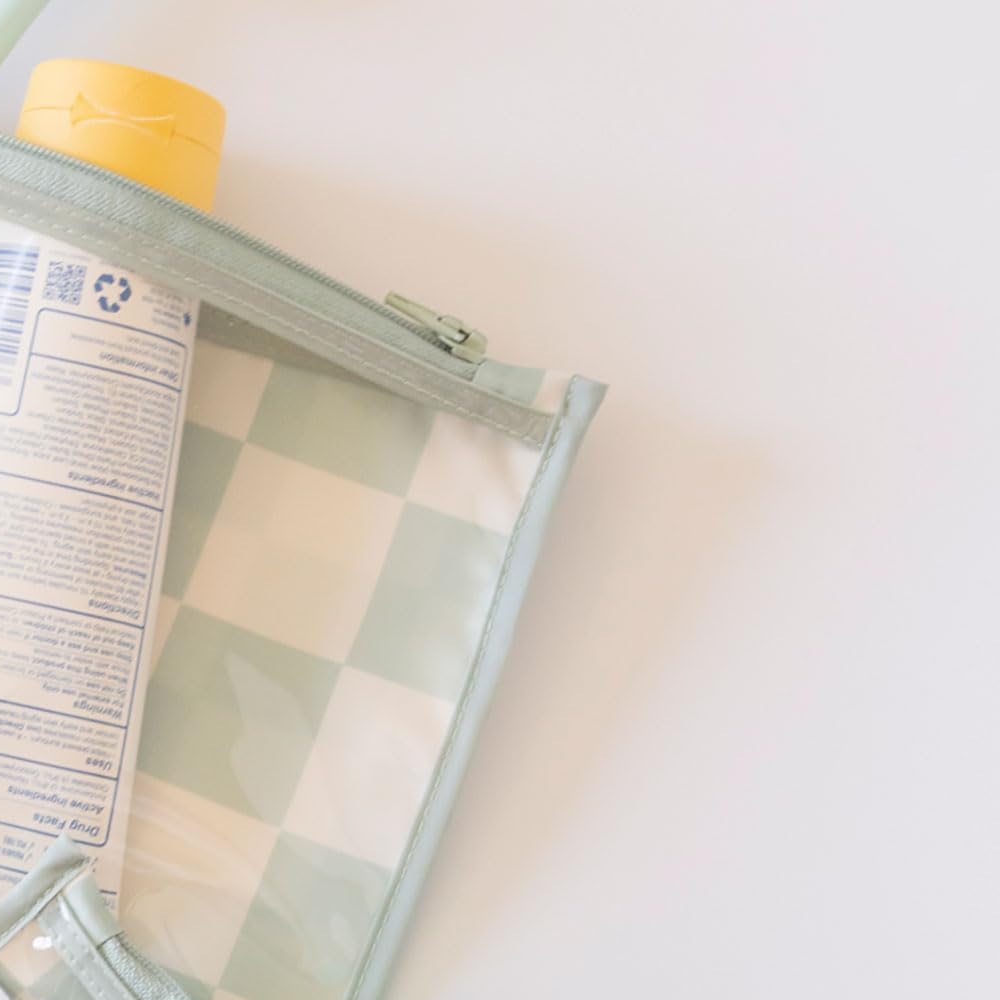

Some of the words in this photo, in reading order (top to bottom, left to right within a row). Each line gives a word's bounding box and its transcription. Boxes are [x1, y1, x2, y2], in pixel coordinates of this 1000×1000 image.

[67, 470, 126, 492] ingredients
[87, 598, 140, 619] Directions
[72, 699, 122, 719] Warnings
[85, 756, 112, 770] Uses
[6, 784, 68, 806] ingredients
[69, 799, 103, 815] Active
[32, 812, 66, 829] Facts
[68, 819, 100, 837] Drug
